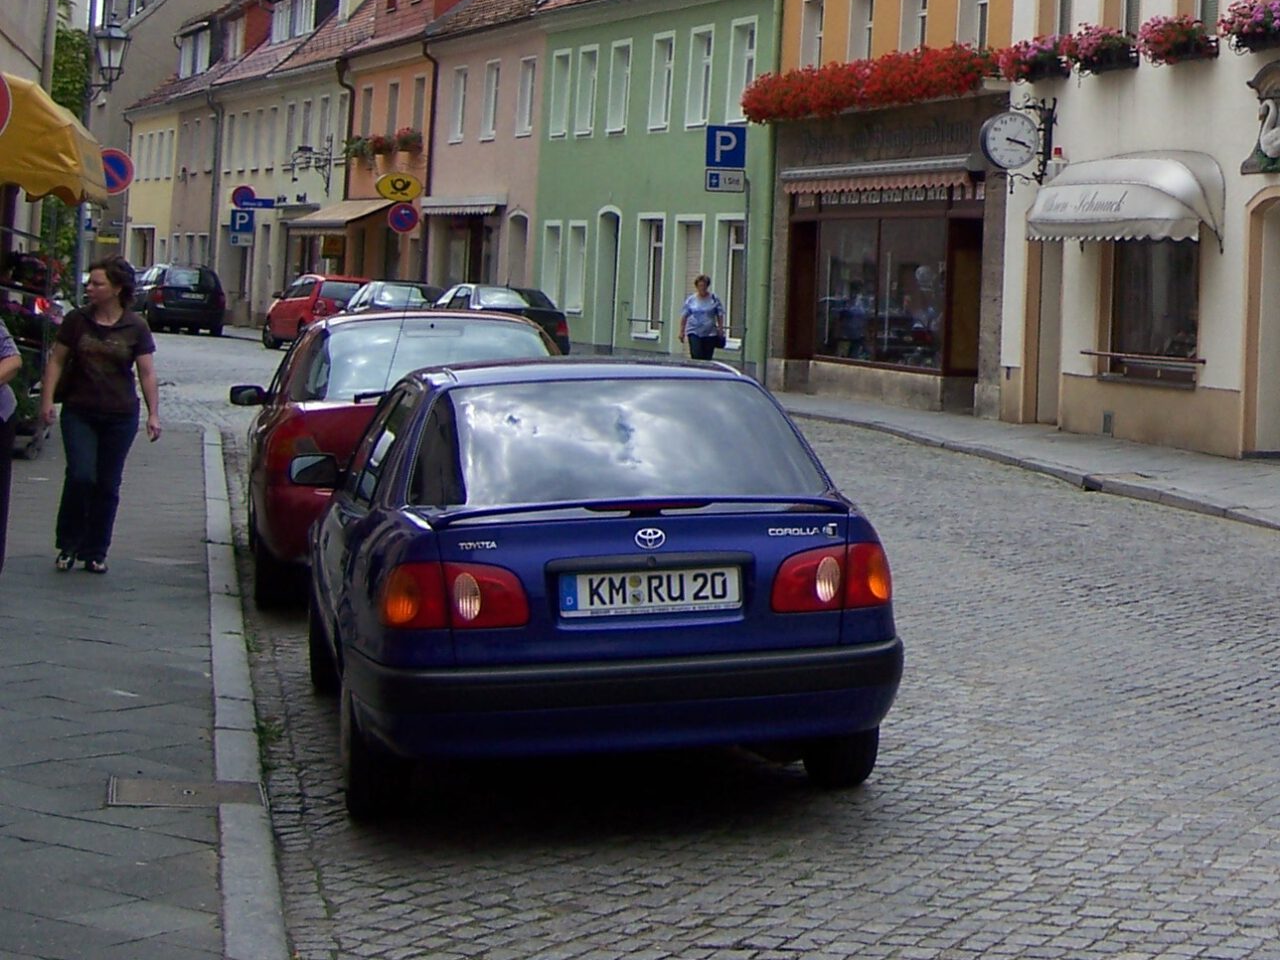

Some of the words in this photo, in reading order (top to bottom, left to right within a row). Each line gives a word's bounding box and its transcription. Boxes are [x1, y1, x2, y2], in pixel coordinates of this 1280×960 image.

[715, 130, 737, 163] P
[235, 212, 250, 231] P
[768, 526, 820, 536] COROLLA
[458, 541, 498, 550] TOYOTA
[588, 576, 627, 607] KM
[647, 573, 685, 603] RU
[692, 571, 728, 601] 20
[566, 597, 573, 606] D
